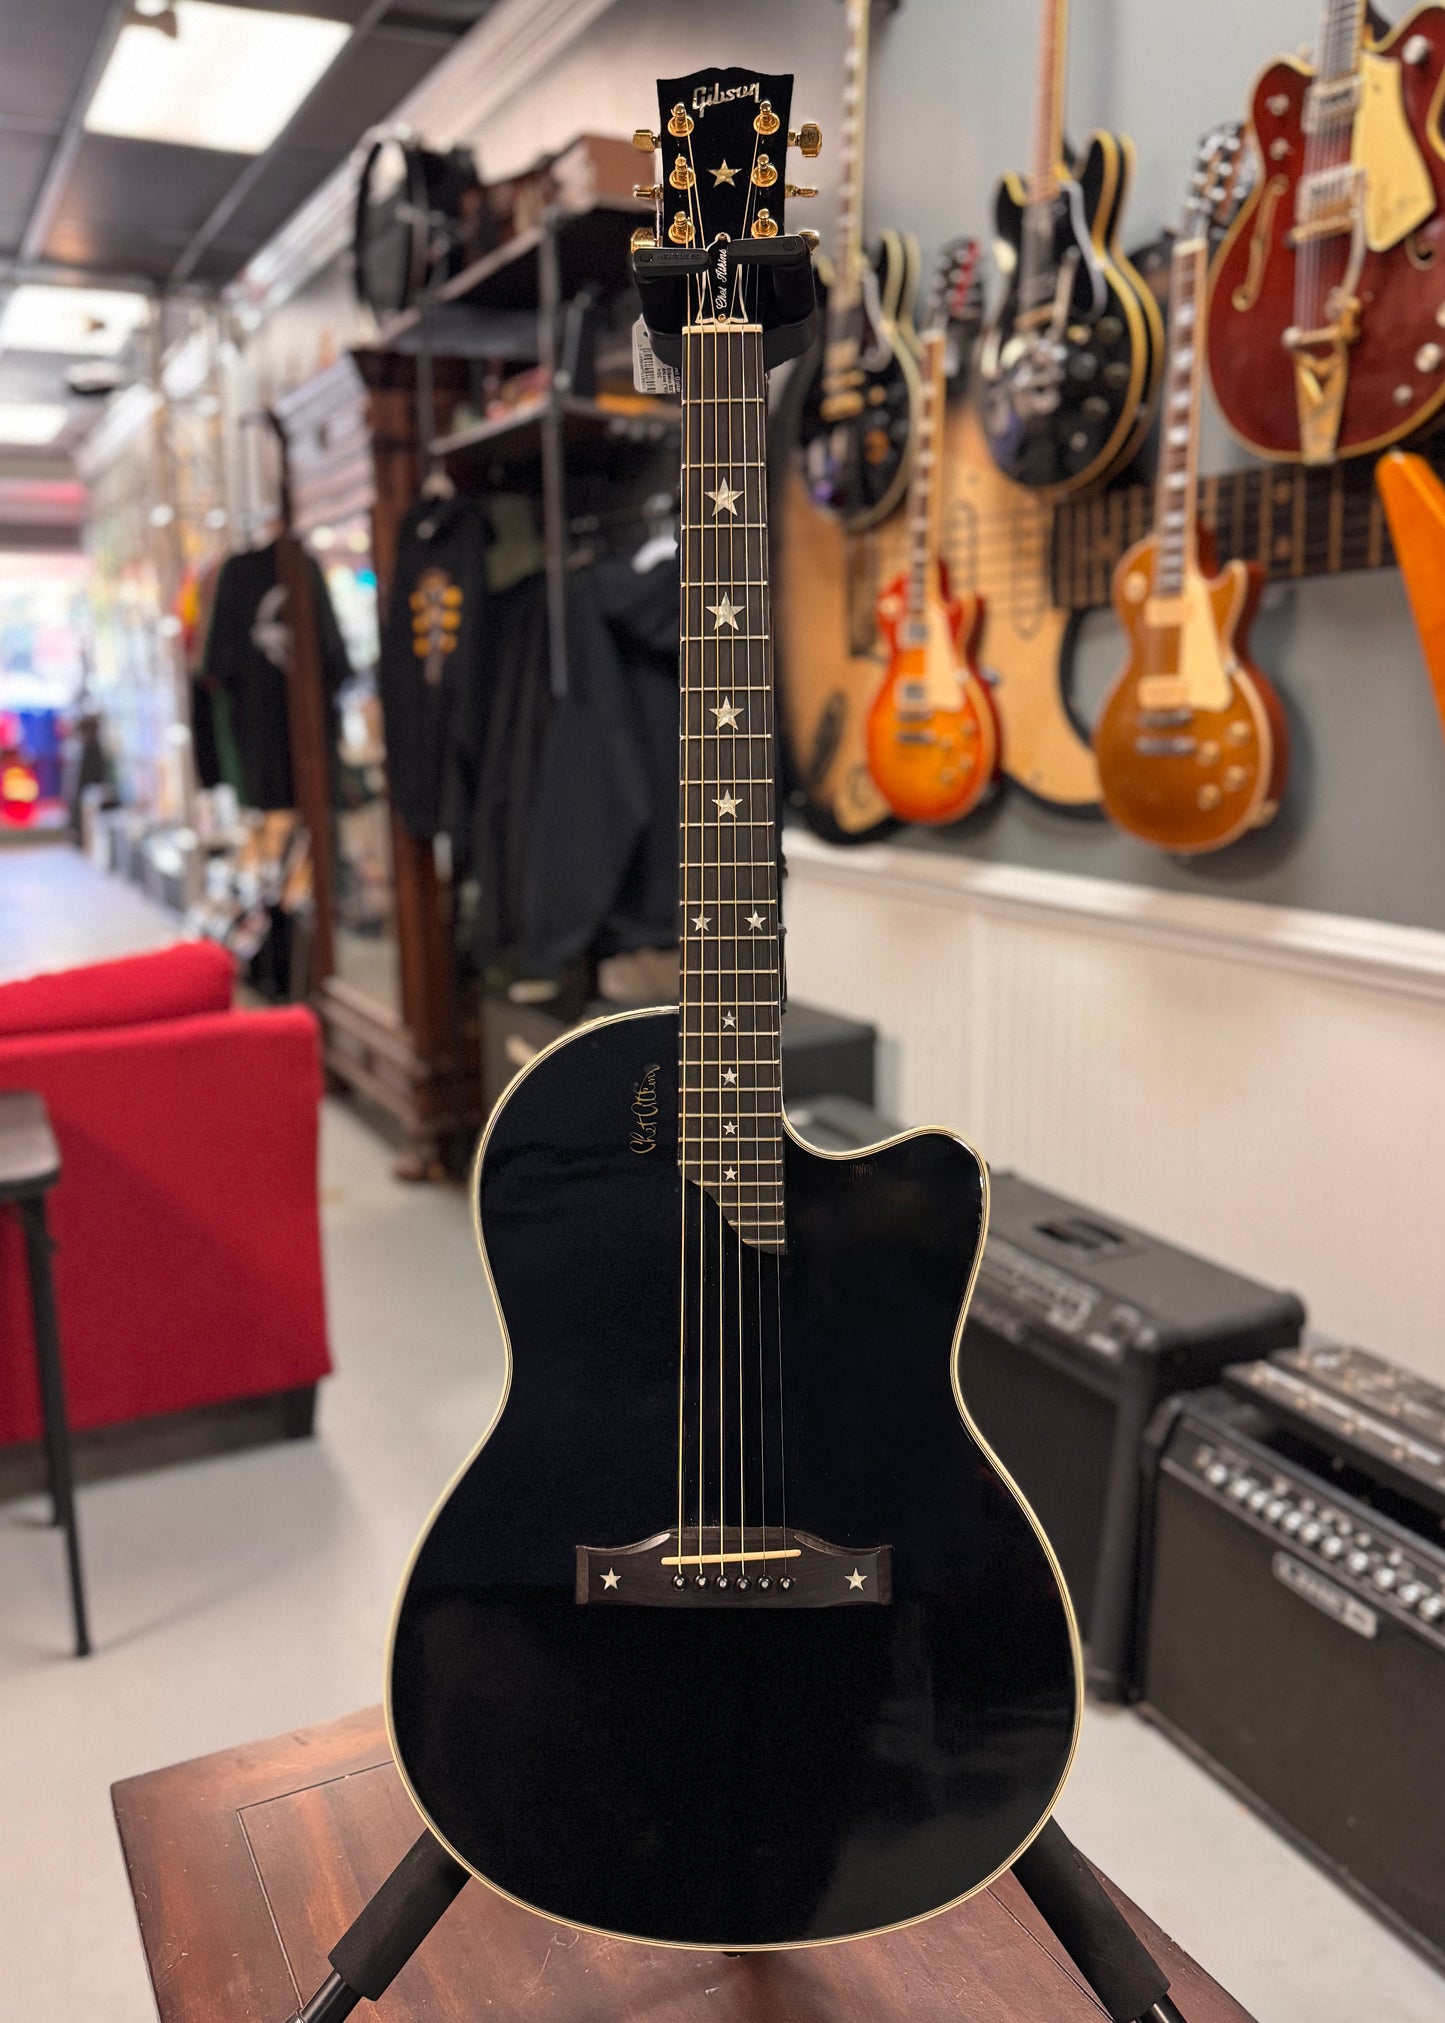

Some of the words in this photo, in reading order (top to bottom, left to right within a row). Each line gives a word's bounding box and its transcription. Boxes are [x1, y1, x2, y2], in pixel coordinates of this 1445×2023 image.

[692, 82, 761, 118] Gibson
[715, 248, 728, 283] Atkins
[715, 286, 727, 310] Chet
[630, 1065, 661, 1118] Atkins
[629, 1113, 658, 1155] Chet
